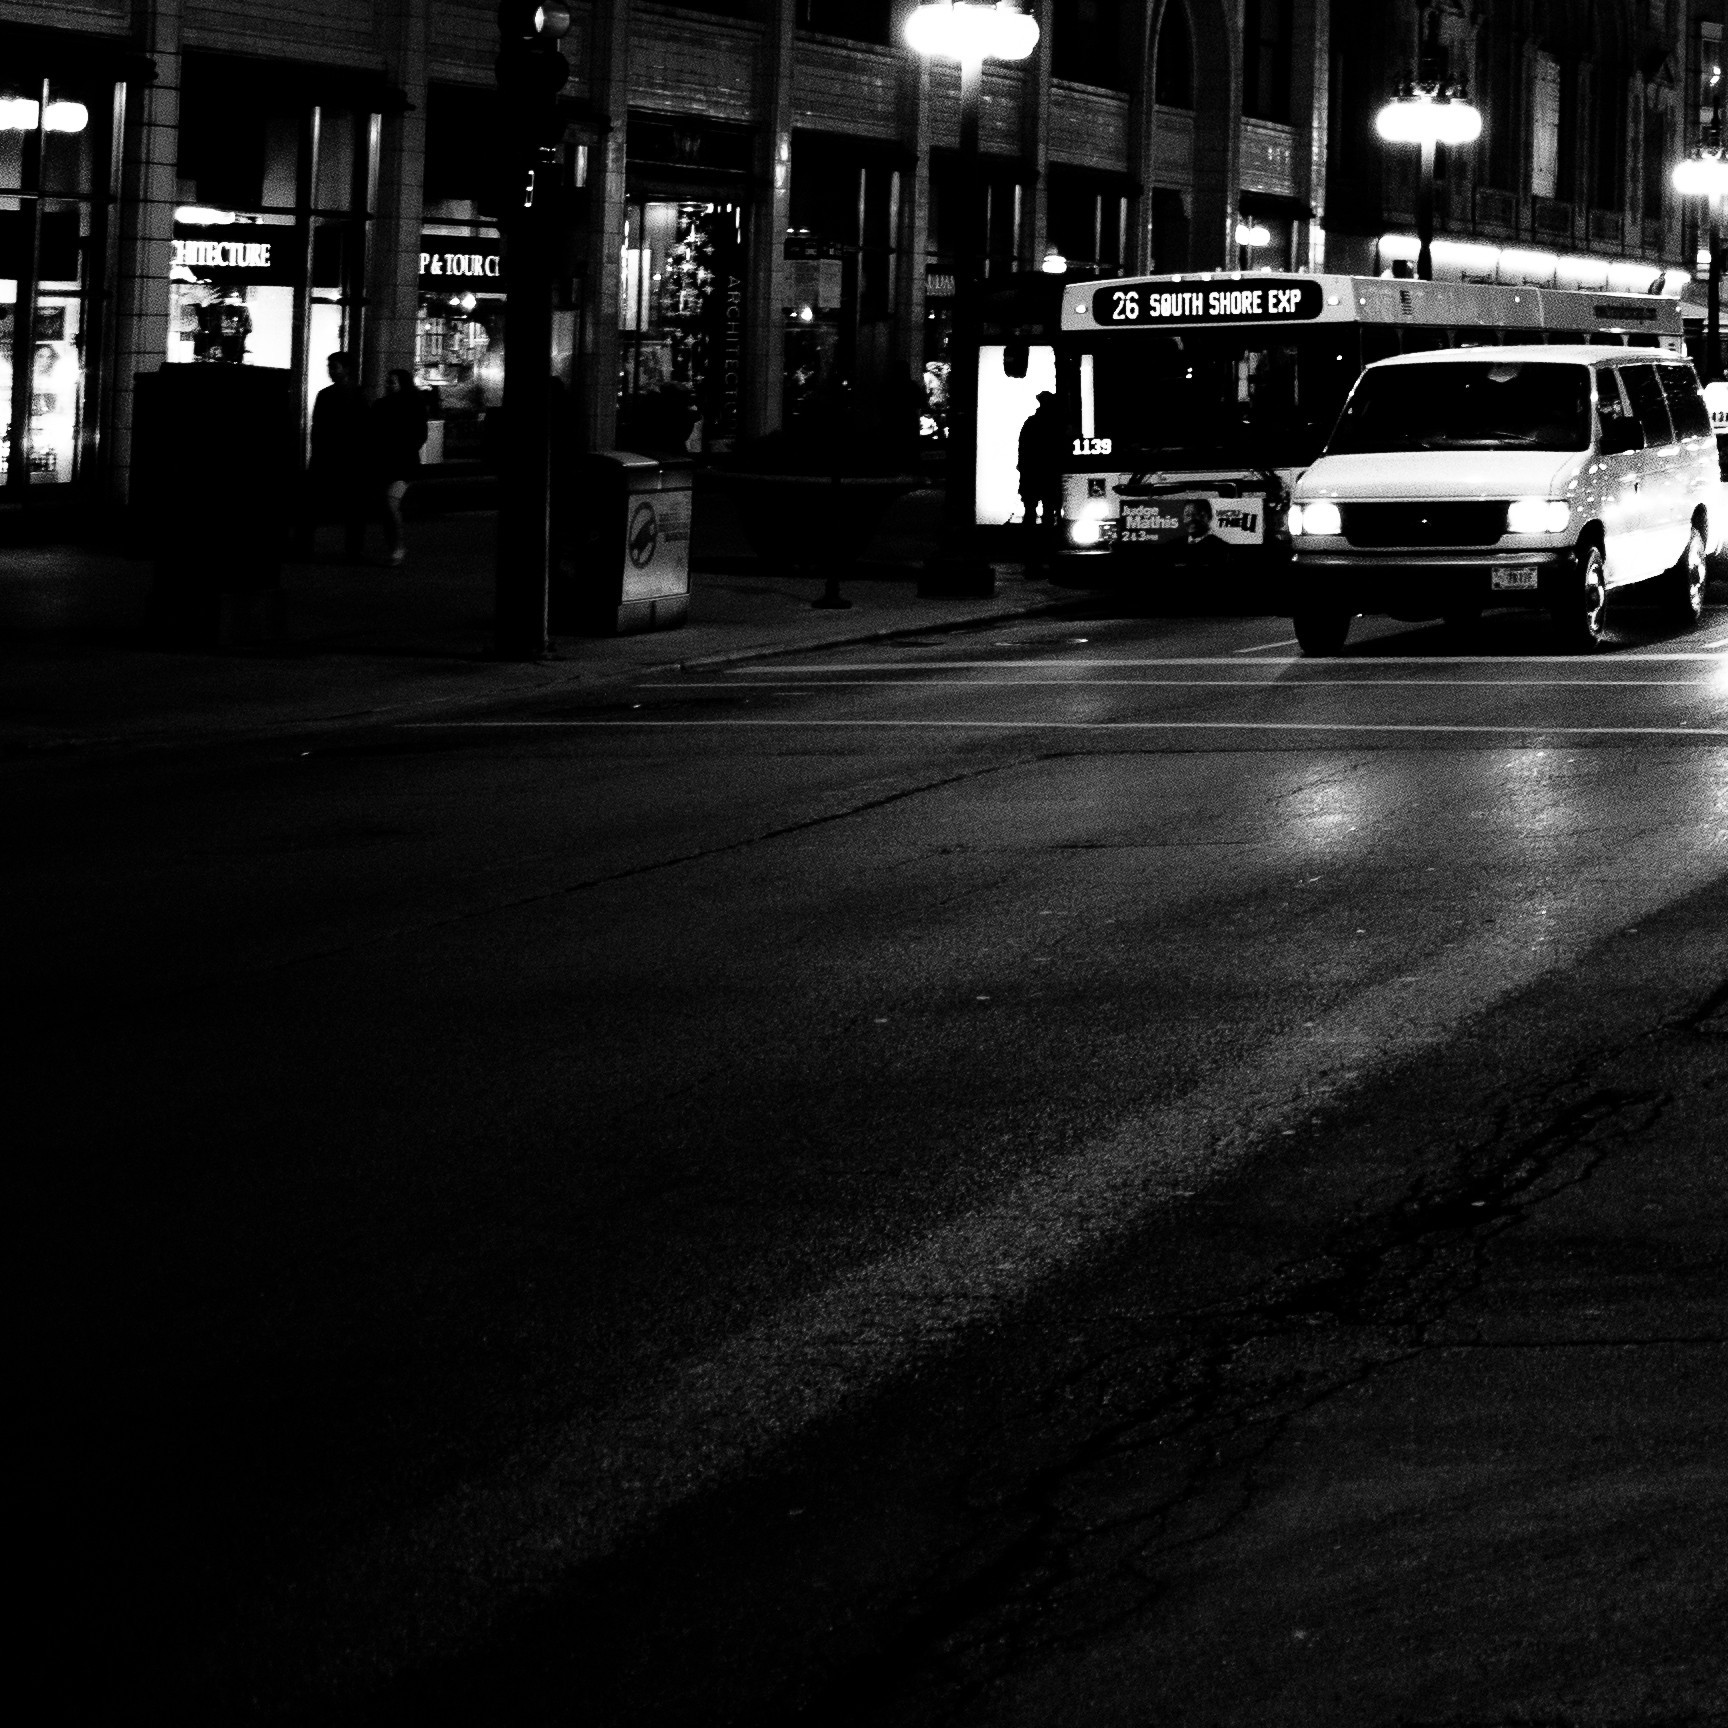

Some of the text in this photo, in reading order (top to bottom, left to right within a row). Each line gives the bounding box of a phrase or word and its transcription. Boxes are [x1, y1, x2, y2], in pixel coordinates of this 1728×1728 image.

[444, 253, 482, 276] TOUR
[1112, 288, 1302, 320] 26 SOUTH SHORE EXP
[1072, 438, 1113, 456] 1139
